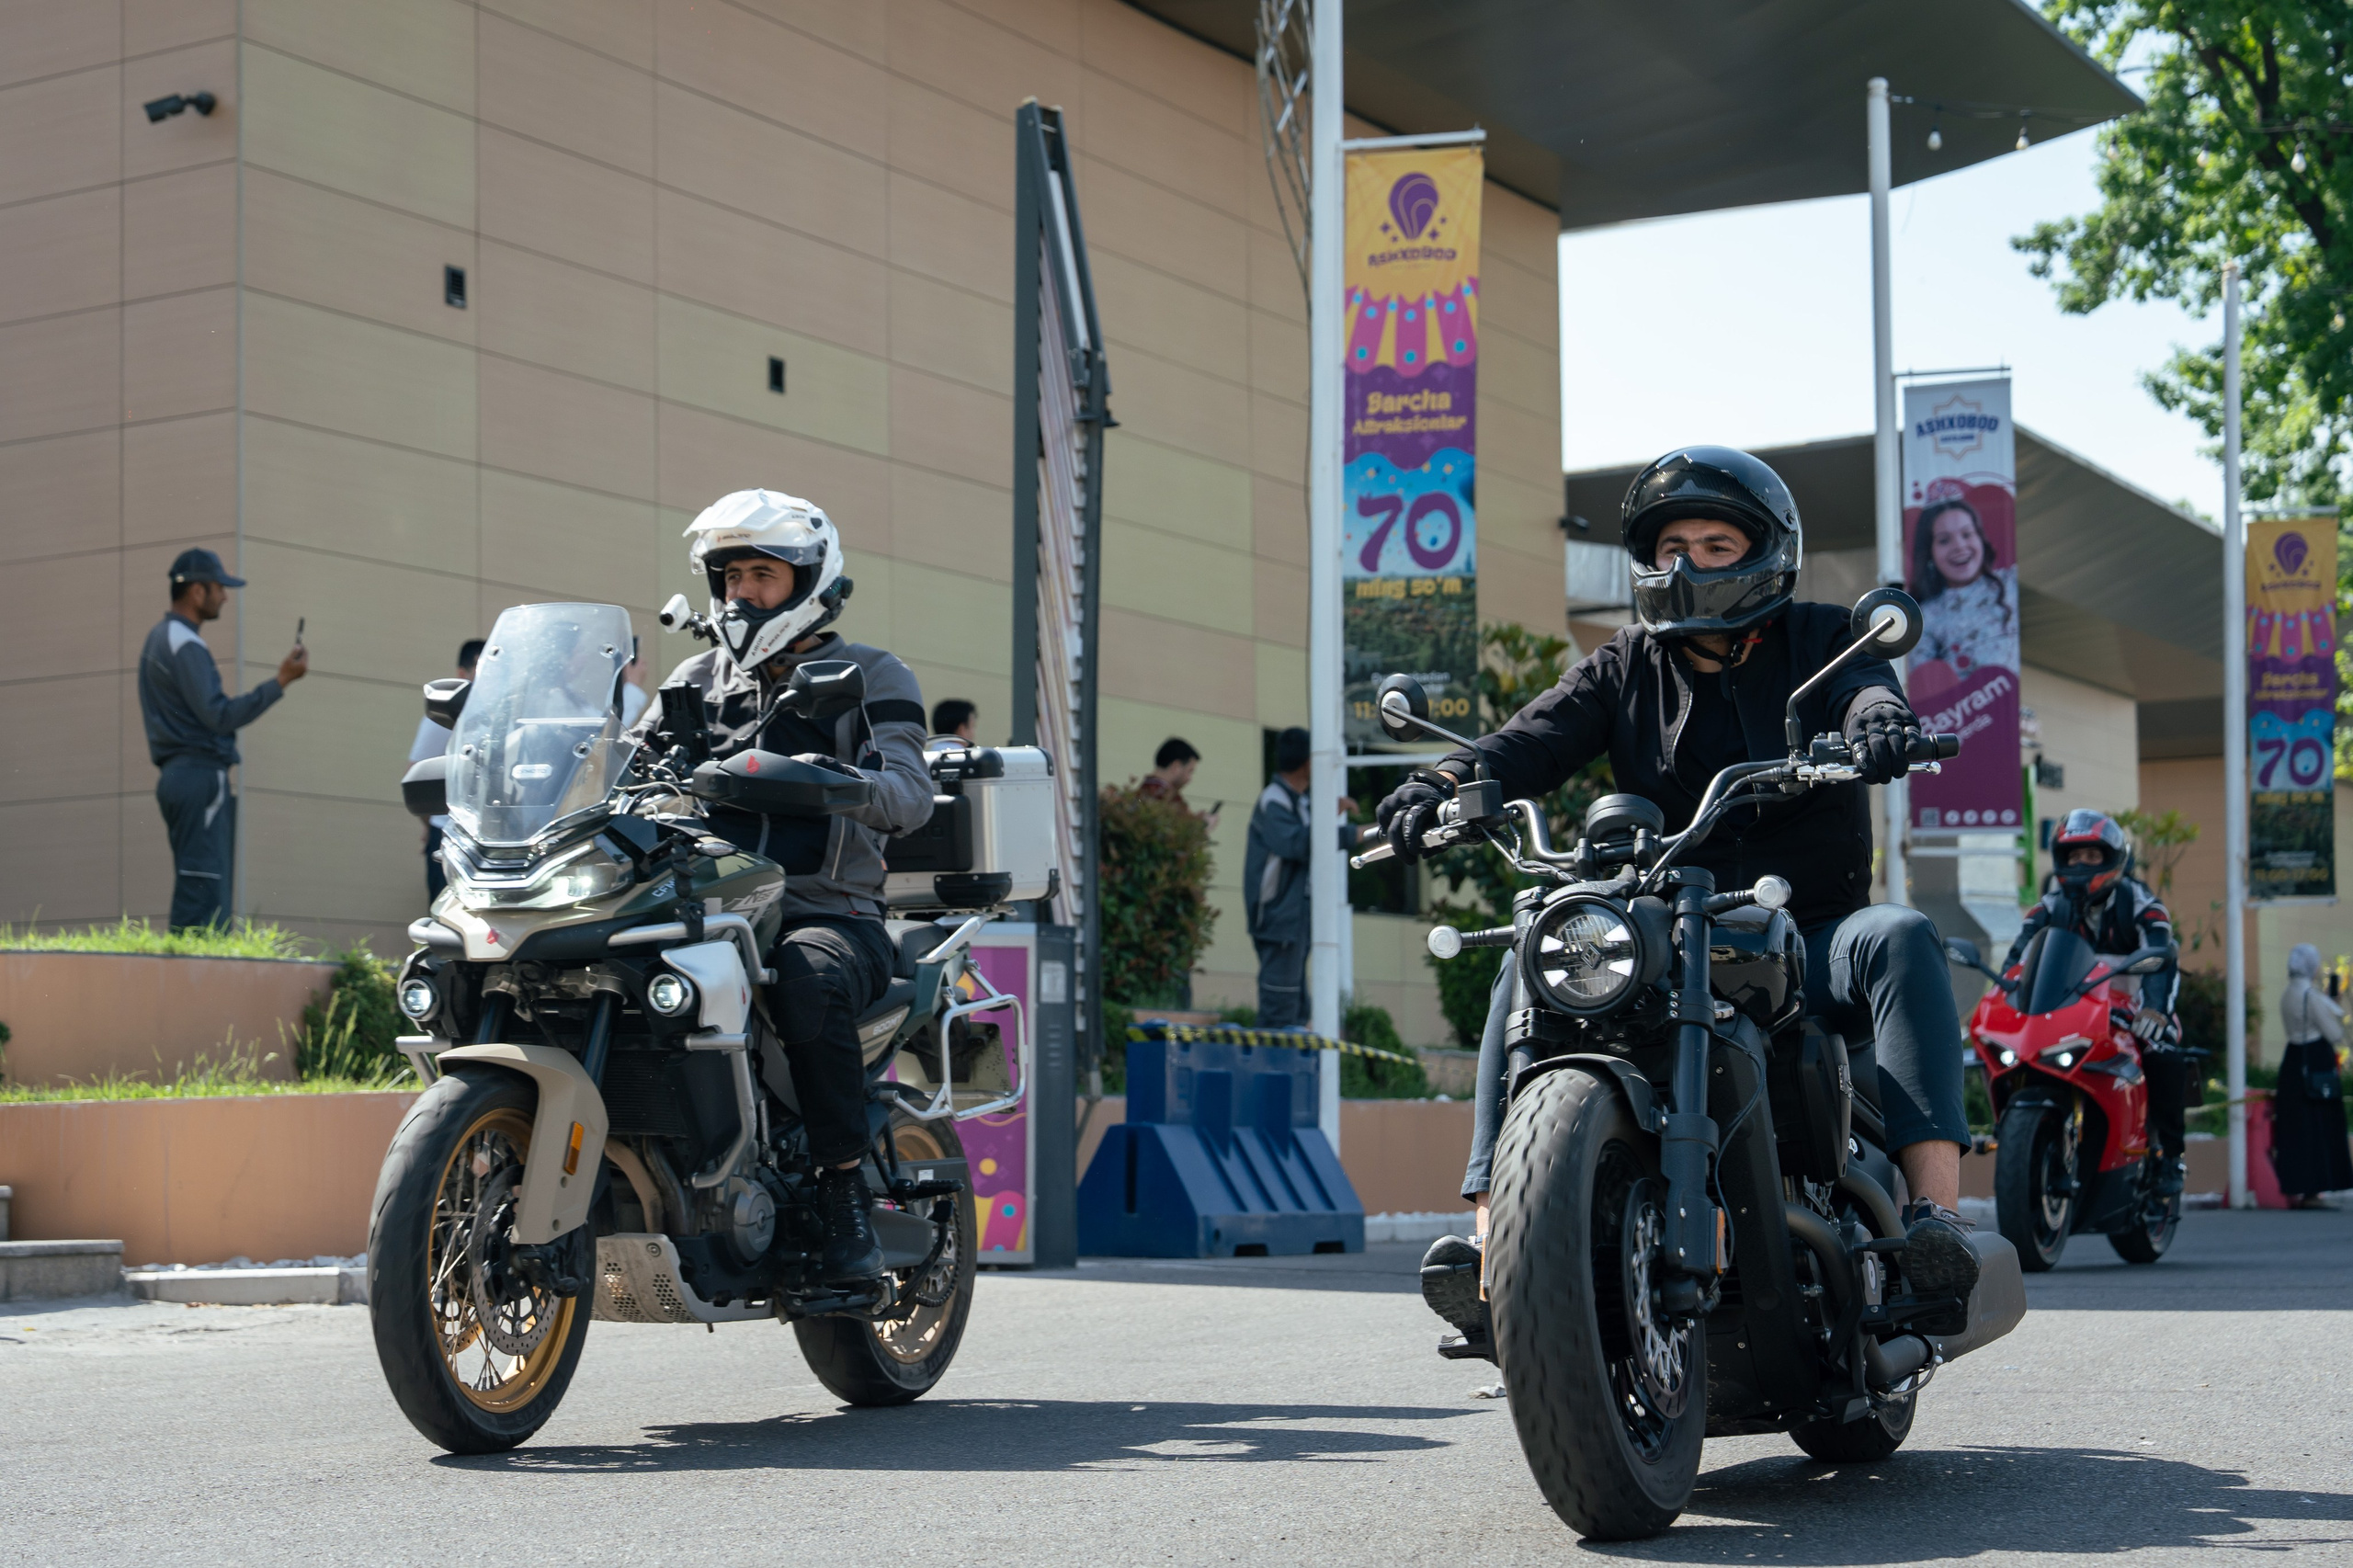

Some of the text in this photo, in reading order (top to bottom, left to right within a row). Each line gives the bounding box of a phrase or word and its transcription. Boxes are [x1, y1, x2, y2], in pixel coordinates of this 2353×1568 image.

[1367, 388, 1452, 415] Barcha
[1915, 414, 2000, 439] ASHXOBOD
[1357, 490, 1461, 574] 70
[1918, 674, 2012, 737] Bayram
[2257, 736, 2325, 788] 70
